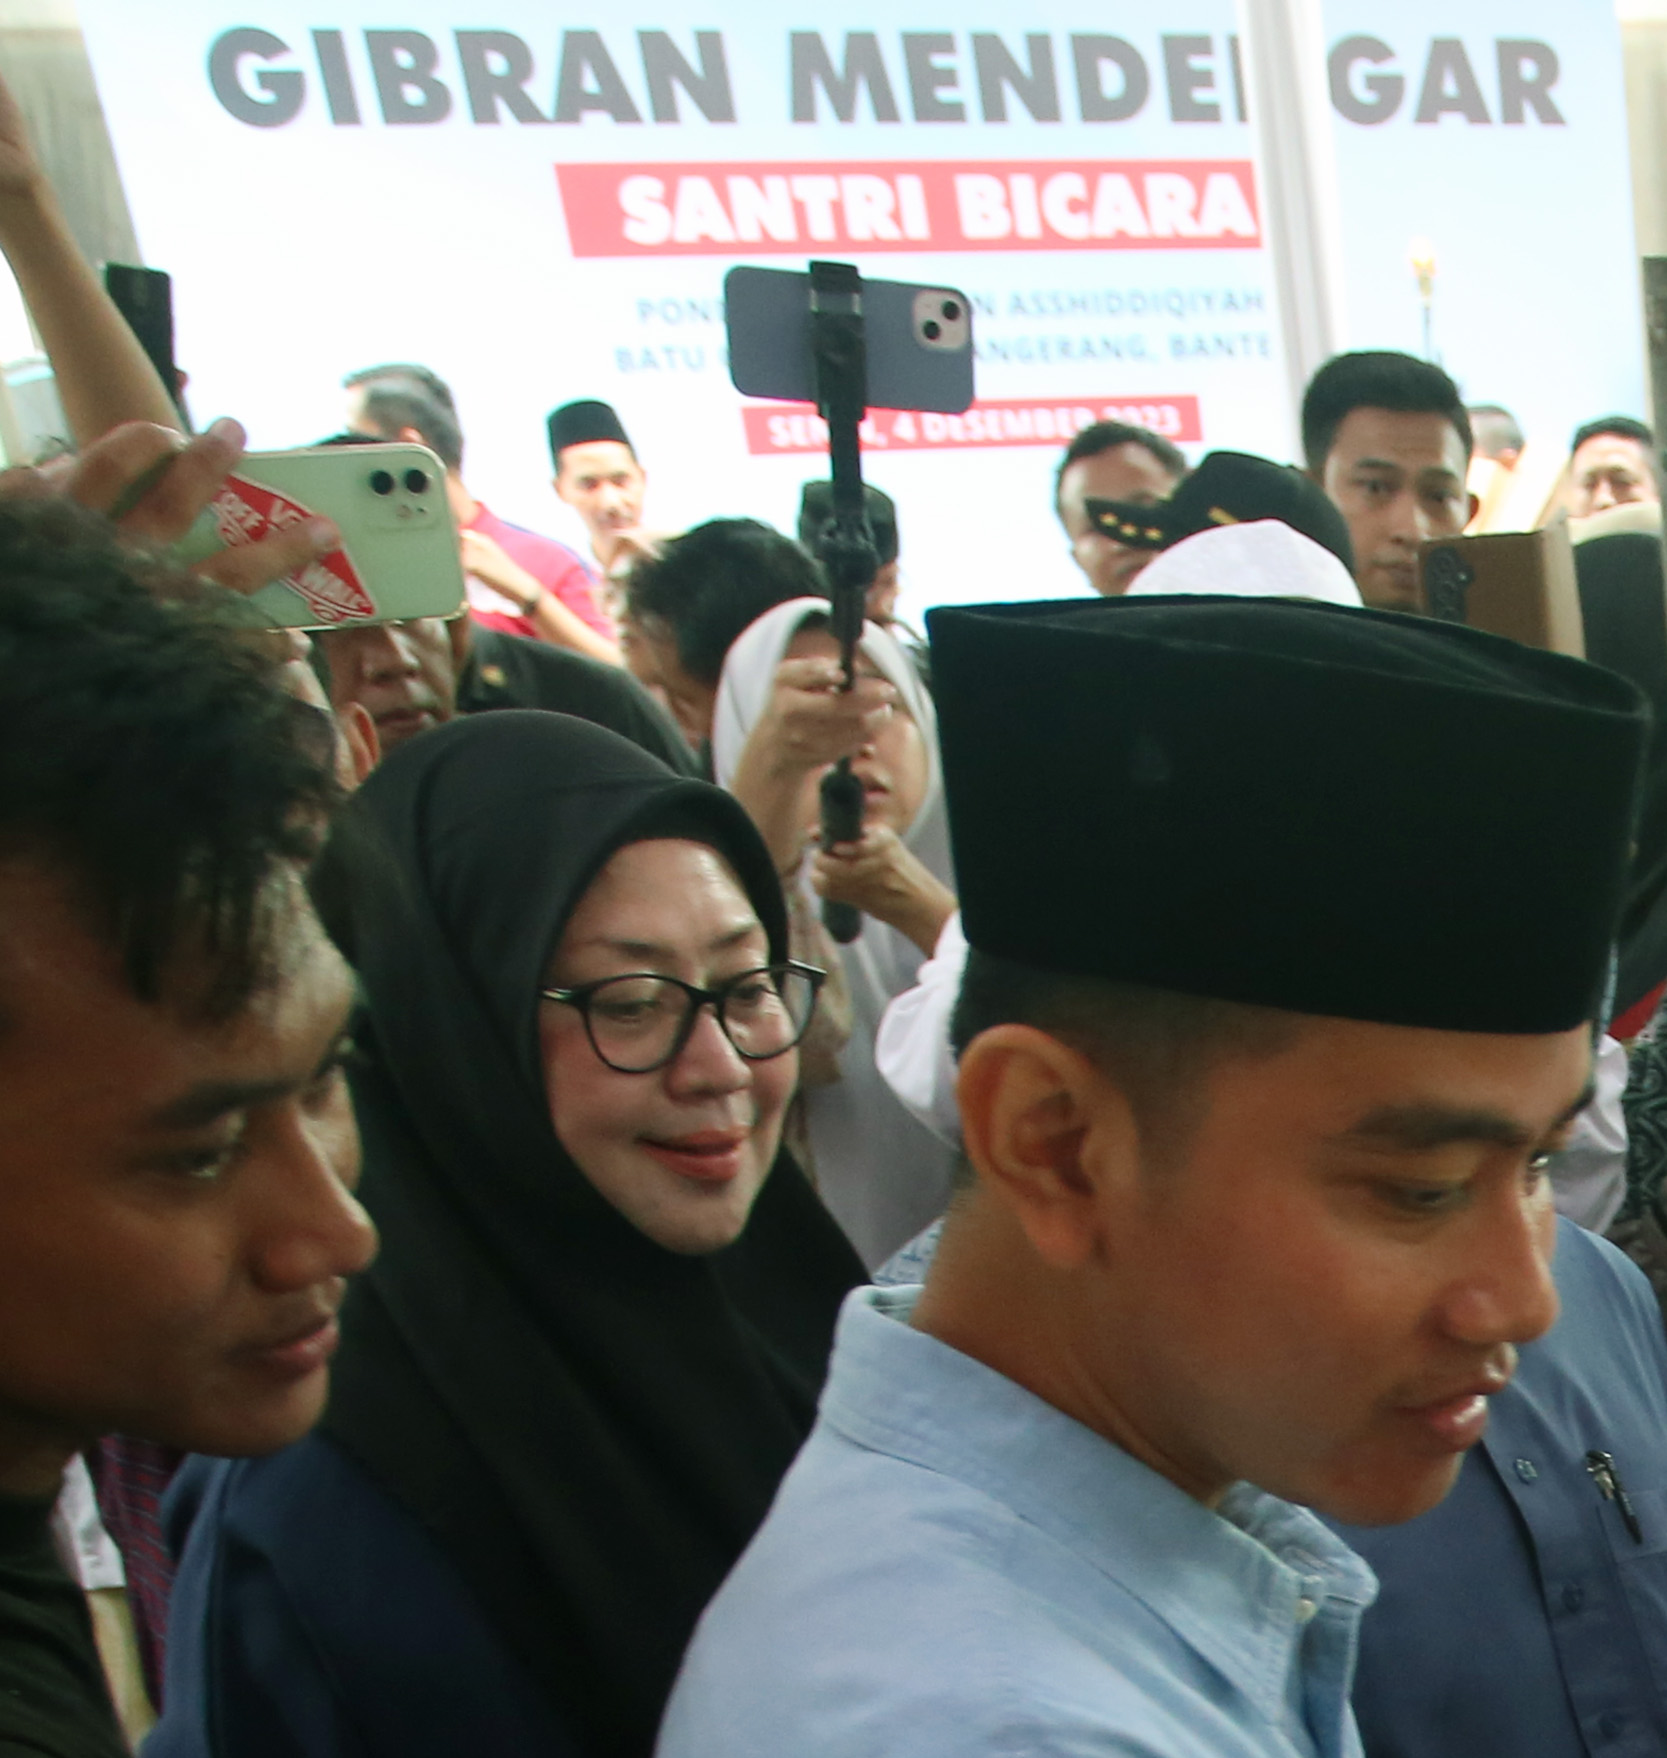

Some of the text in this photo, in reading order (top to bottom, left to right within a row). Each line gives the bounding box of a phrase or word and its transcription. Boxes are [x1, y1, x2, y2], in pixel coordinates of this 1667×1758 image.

[208, 27, 1567, 128] GIBRAN MENDEGAR
[618, 171, 1257, 245] SANTRI BICARA
[614, 344, 707, 373] BATU
[894, 411, 916, 442] 4
